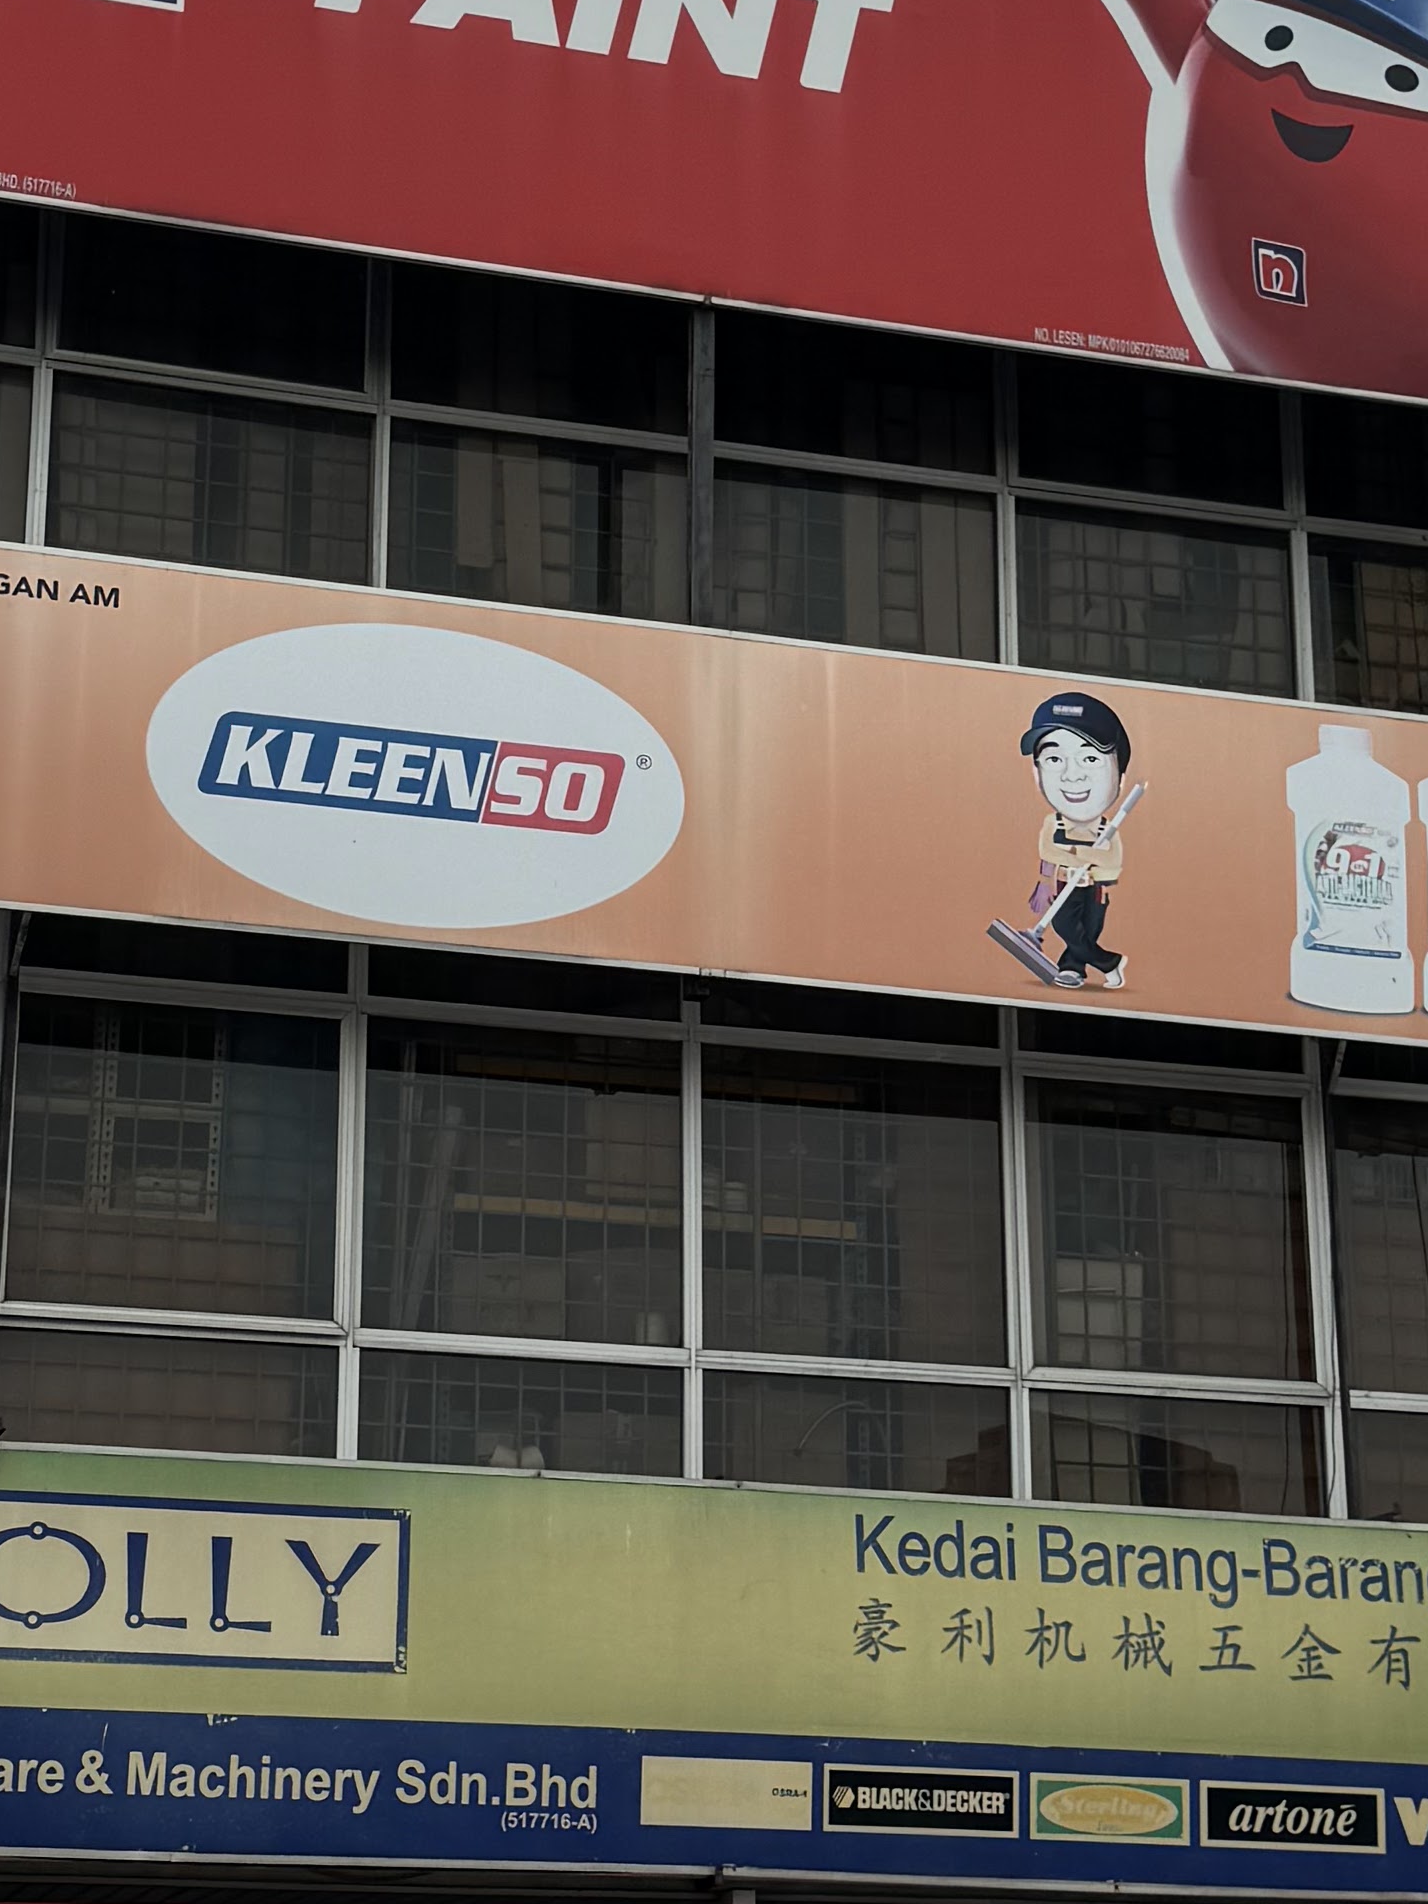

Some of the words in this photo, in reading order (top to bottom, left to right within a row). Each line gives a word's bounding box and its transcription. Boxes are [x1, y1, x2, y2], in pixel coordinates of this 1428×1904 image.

[22, 175, 77, 198] (517716-A)
[1034, 327, 1052, 343] NO.
[1053, 329, 1086, 347] LESEN:
[68, 582, 122, 610] AM
[213, 722, 609, 826] KLEENSO
[854, 1513, 1018, 1586] Kedai
[75, 1753, 113, 1796] &
[126, 1750, 380, 1815] Machinery
[394, 1757, 598, 1810] Sdn.Bhd
[500, 1808, 598, 1834] (517716-A)
